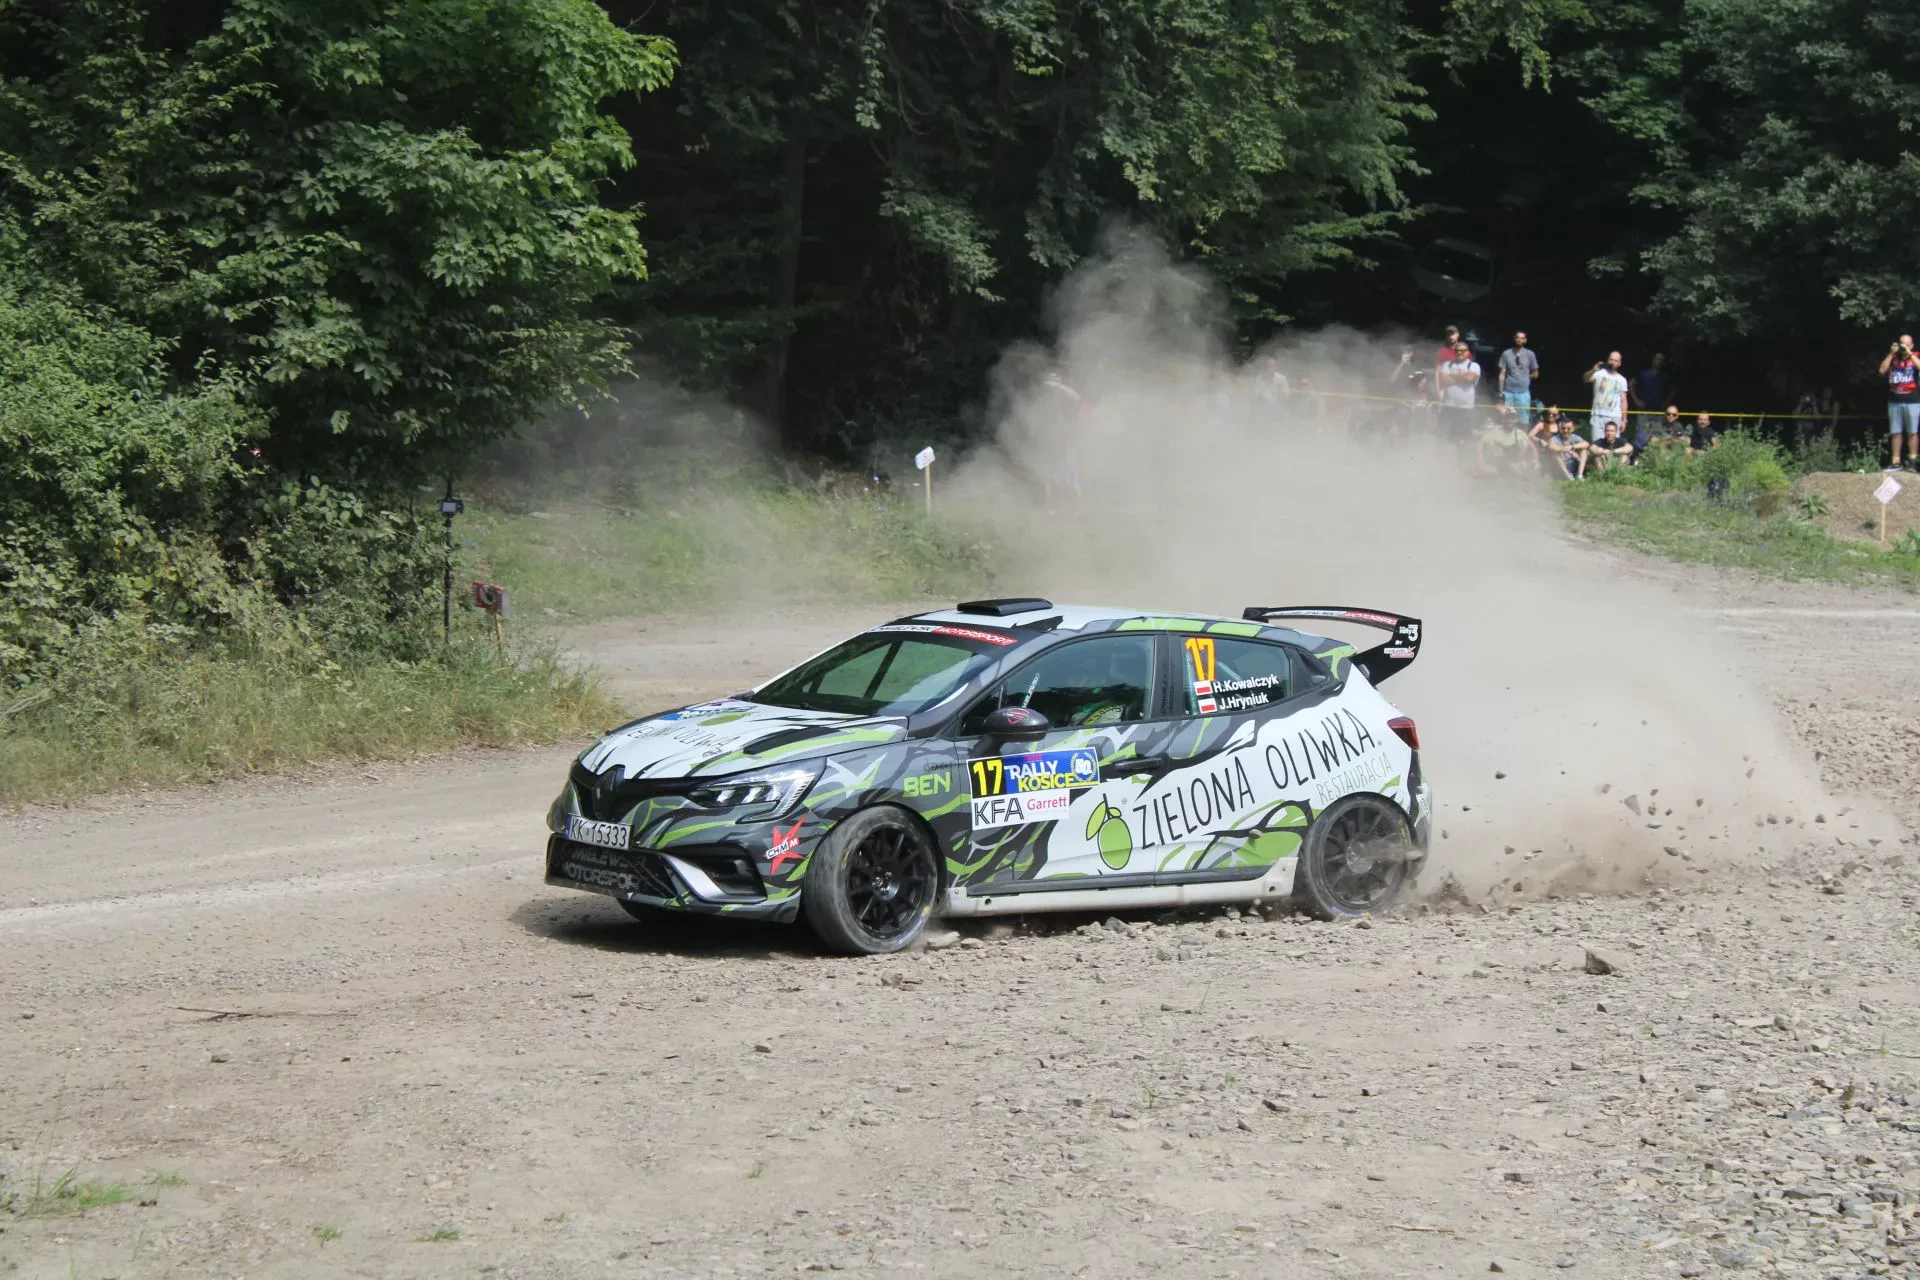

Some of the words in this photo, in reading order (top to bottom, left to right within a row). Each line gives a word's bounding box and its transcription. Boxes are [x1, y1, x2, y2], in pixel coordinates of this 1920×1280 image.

[1185, 637, 1215, 682] 17
[1213, 674, 1279, 693] H.Kowalczyk
[1220, 692, 1269, 710] J.Hryniuk
[903, 772, 951, 797] BEN
[973, 759, 1003, 796] 17
[1004, 760, 1058, 780] RALLY
[1133, 756, 1256, 849] ZIELONA
[1265, 708, 1376, 790] OLIWKA
[1316, 751, 1394, 806] RESTAURACJA
[974, 797, 1024, 826] KFA
[1027, 797, 1067, 811] Garrett
[570, 817, 588, 841] KK
[591, 823, 627, 848] 15333
